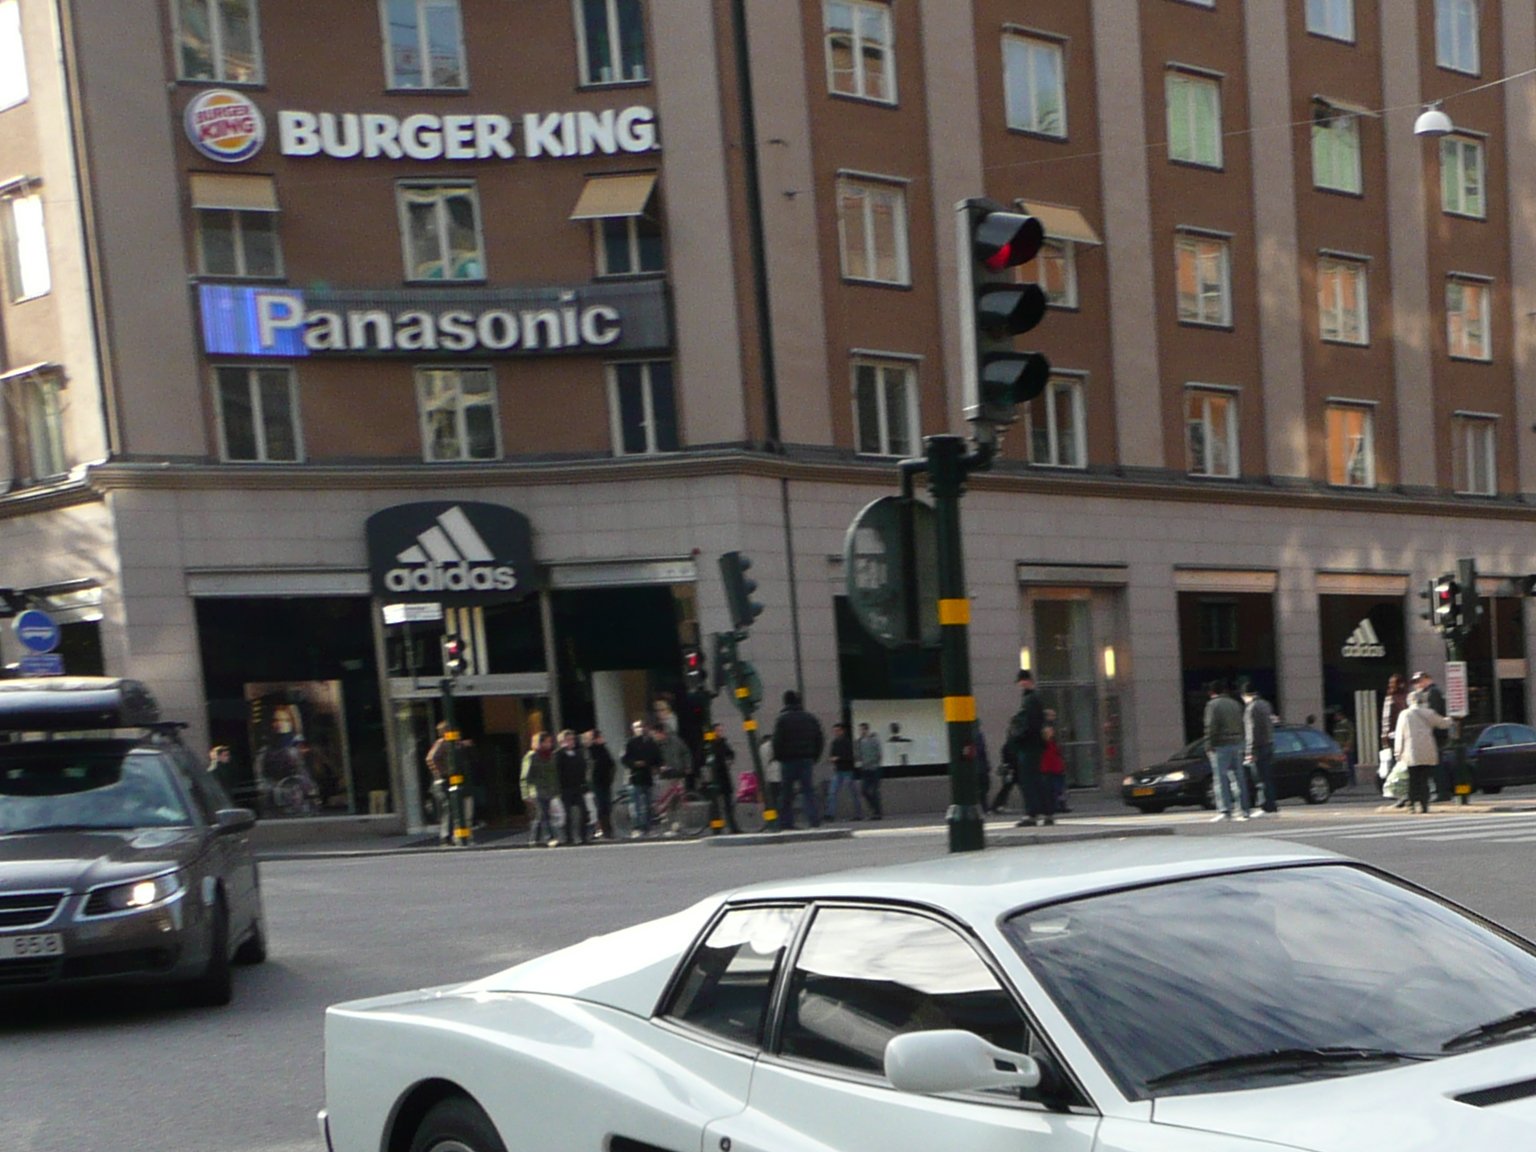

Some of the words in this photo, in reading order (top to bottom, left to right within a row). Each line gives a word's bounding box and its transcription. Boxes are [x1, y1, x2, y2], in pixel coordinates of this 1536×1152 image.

[197, 104, 250, 123] BURGER
[199, 117, 254, 142] KING
[277, 110, 515, 160] BURGER
[523, 105, 657, 158] KING
[255, 291, 621, 351] Panasonic
[384, 561, 517, 592] adidas
[1341, 643, 1386, 658] adidas
